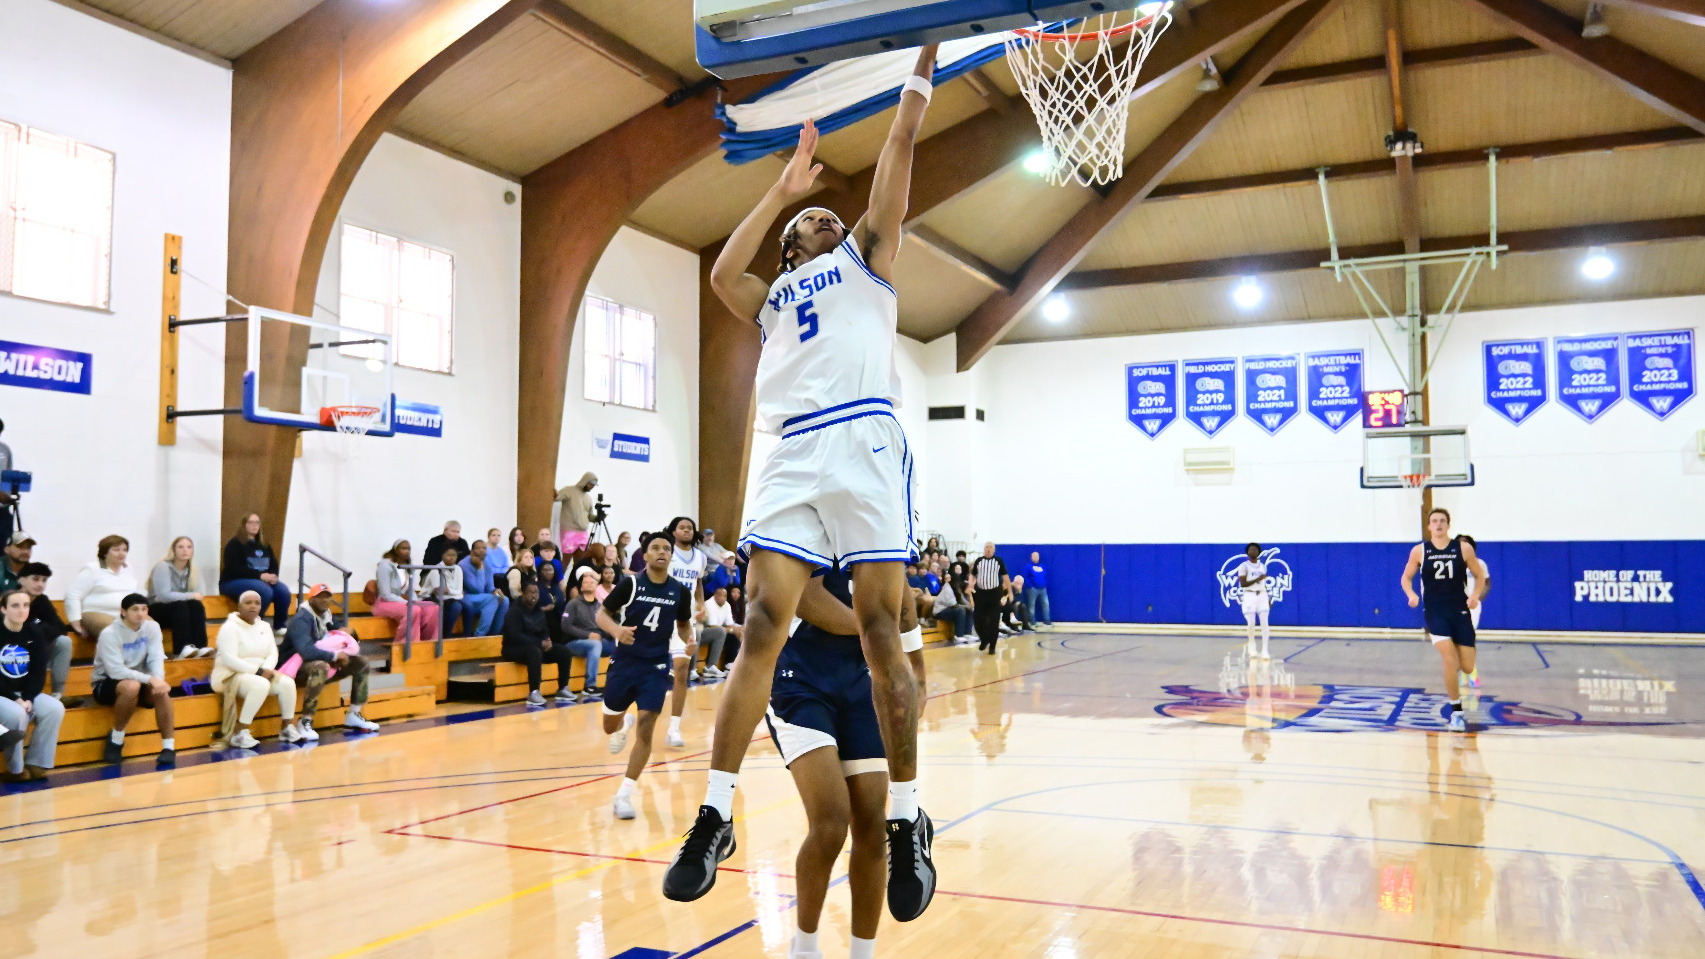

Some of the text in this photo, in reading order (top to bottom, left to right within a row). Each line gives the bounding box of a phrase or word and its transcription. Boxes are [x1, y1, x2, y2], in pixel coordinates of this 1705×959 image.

[769, 265, 842, 312] WILSON
[796, 300, 819, 343] 5
[1557, 340, 1617, 351] FIELD HOCKEY
[1628, 334, 1690, 348] BASKETBALL
[1491, 344, 1539, 356] SOFTBALL
[0, 350, 83, 384] WILSON
[1245, 360, 1297, 370] FIELD HOCKEY
[1308, 355, 1360, 366] BASKETBALL
[1132, 366, 1171, 377] SOFTBALL
[1185, 363, 1235, 374] FIELD HOCKEY
[1499, 376, 1533, 390] 2022
[1571, 372, 1607, 386] 2022
[1642, 369, 1678, 383] 2023
[1319, 386, 1350, 399] 2022
[1563, 385, 1616, 395] CHAMPIONS
[1633, 381, 1688, 391] CHAMPIONS
[1196, 392, 1225, 405] 2019
[1257, 389, 1285, 402] 2021
[1491, 389, 1542, 398] CHAMPIONS
[1138, 395, 1166, 407] 2019
[1189, 404, 1232, 412] CHAMPIONS
[1250, 401, 1294, 409] CHAMPIONS
[1312, 398, 1358, 407] CHAMPIONS
[1578, 399, 1602, 415] W
[1649, 396, 1674, 413] W
[1131, 407, 1173, 415] CHAMPIONS
[1370, 404, 1398, 427] 27
[1505, 402, 1528, 419] W
[395, 408, 441, 429] TUDENTS
[1201, 416, 1221, 431] W
[1262, 413, 1282, 429] W
[1325, 411, 1346, 427] W
[1143, 419, 1162, 434] W
[613, 439, 649, 456] STUDENTS
[1433, 560, 1454, 579] 21
[1583, 569, 1662, 582] HOME OF THE
[1574, 581, 1674, 603] PHOENIX
[636, 595, 676, 606] MESSIAH
[642, 606, 662, 632] 4
